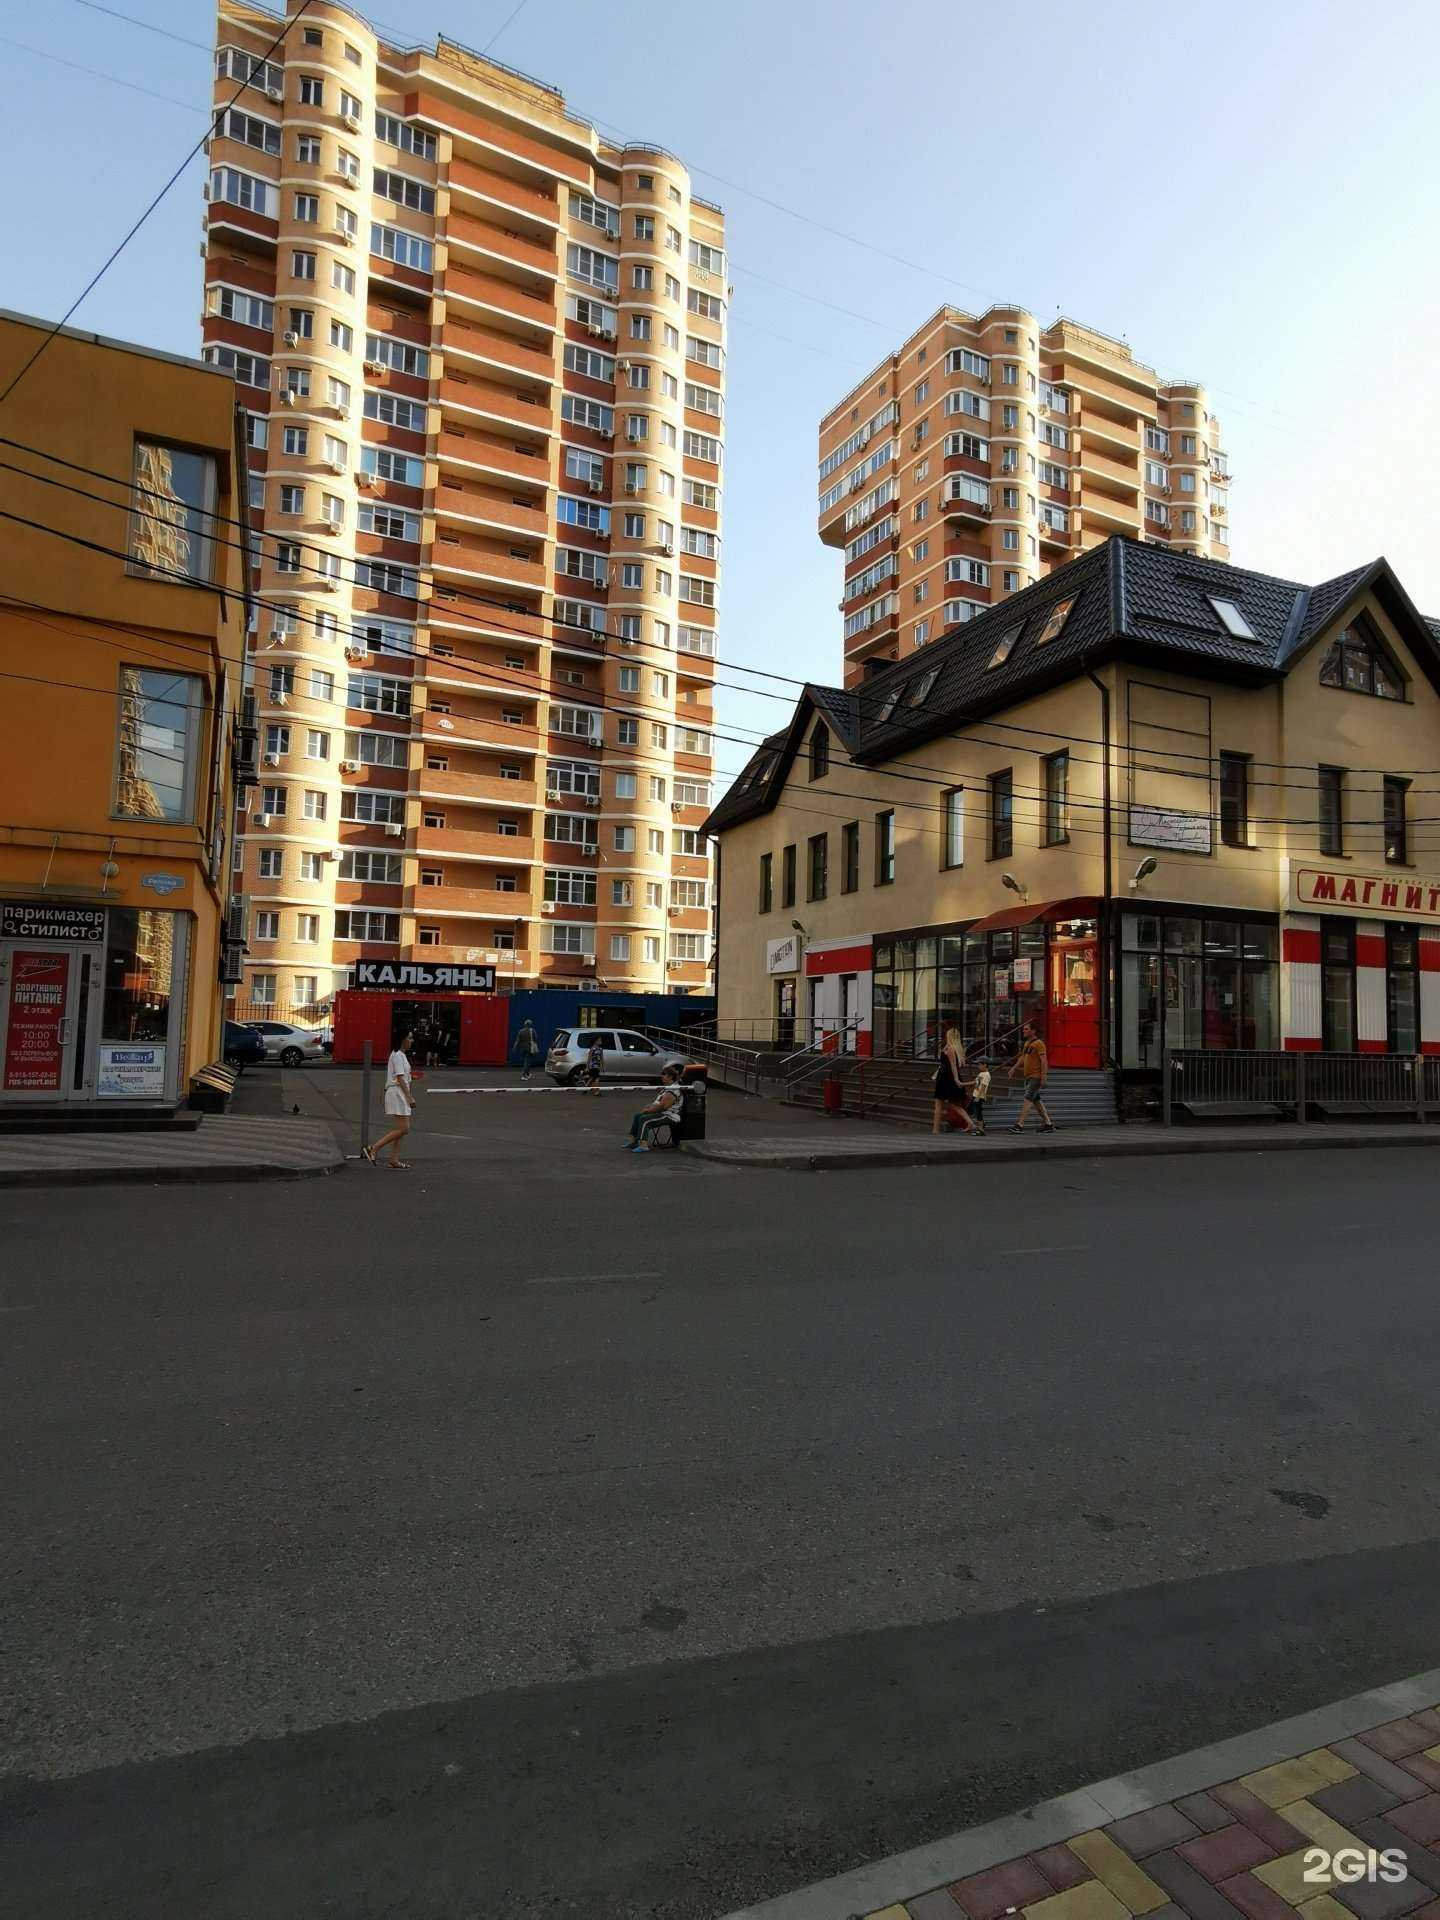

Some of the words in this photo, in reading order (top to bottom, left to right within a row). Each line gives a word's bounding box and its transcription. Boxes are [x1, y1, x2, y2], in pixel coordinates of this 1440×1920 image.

[1312, 875, 1440, 910] МАГНИТ
[4, 907, 104, 925] парикмахер
[359, 964, 493, 987] КАЛЬЯНЫ
[15, 984, 63, 993] СПОРТИВНОЕ
[15, 992, 63, 1004] ПИТАНИЕ
[31, 1007, 54, 1015] этаж
[23, 1031, 50, 1039] 10:00
[21, 1040, 49, 1048] 20:00
